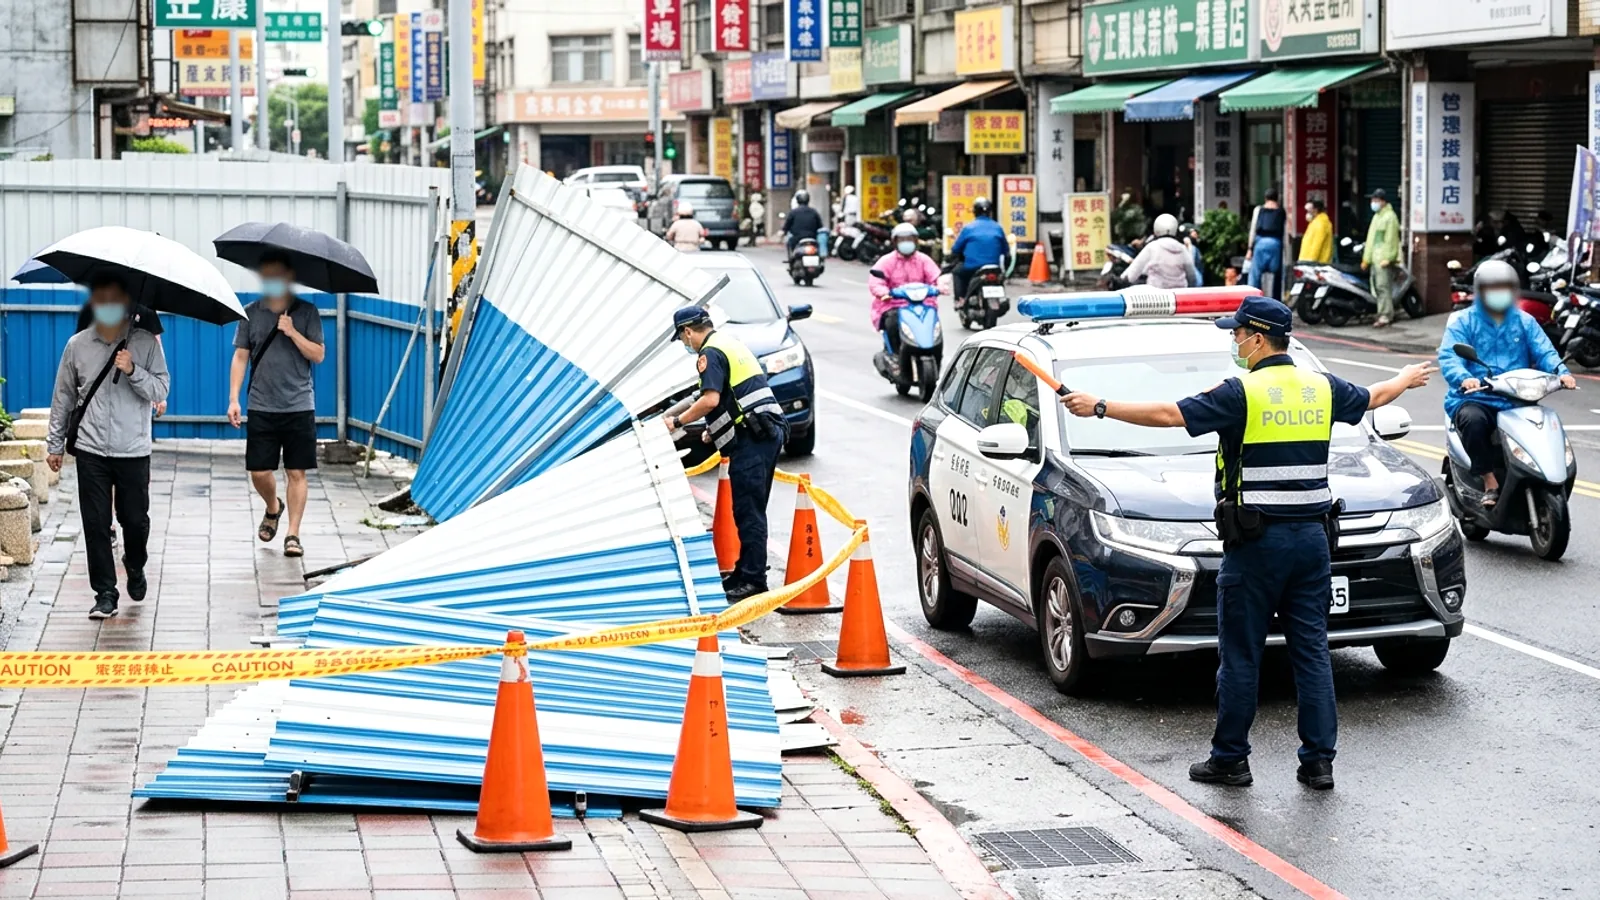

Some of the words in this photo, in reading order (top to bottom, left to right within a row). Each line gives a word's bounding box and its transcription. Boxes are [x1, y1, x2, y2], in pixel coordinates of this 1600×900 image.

[1262, 409, 1325, 427] POLICE
[0, 664, 71, 676] AUTION
[212, 660, 294, 674] CAUTION
